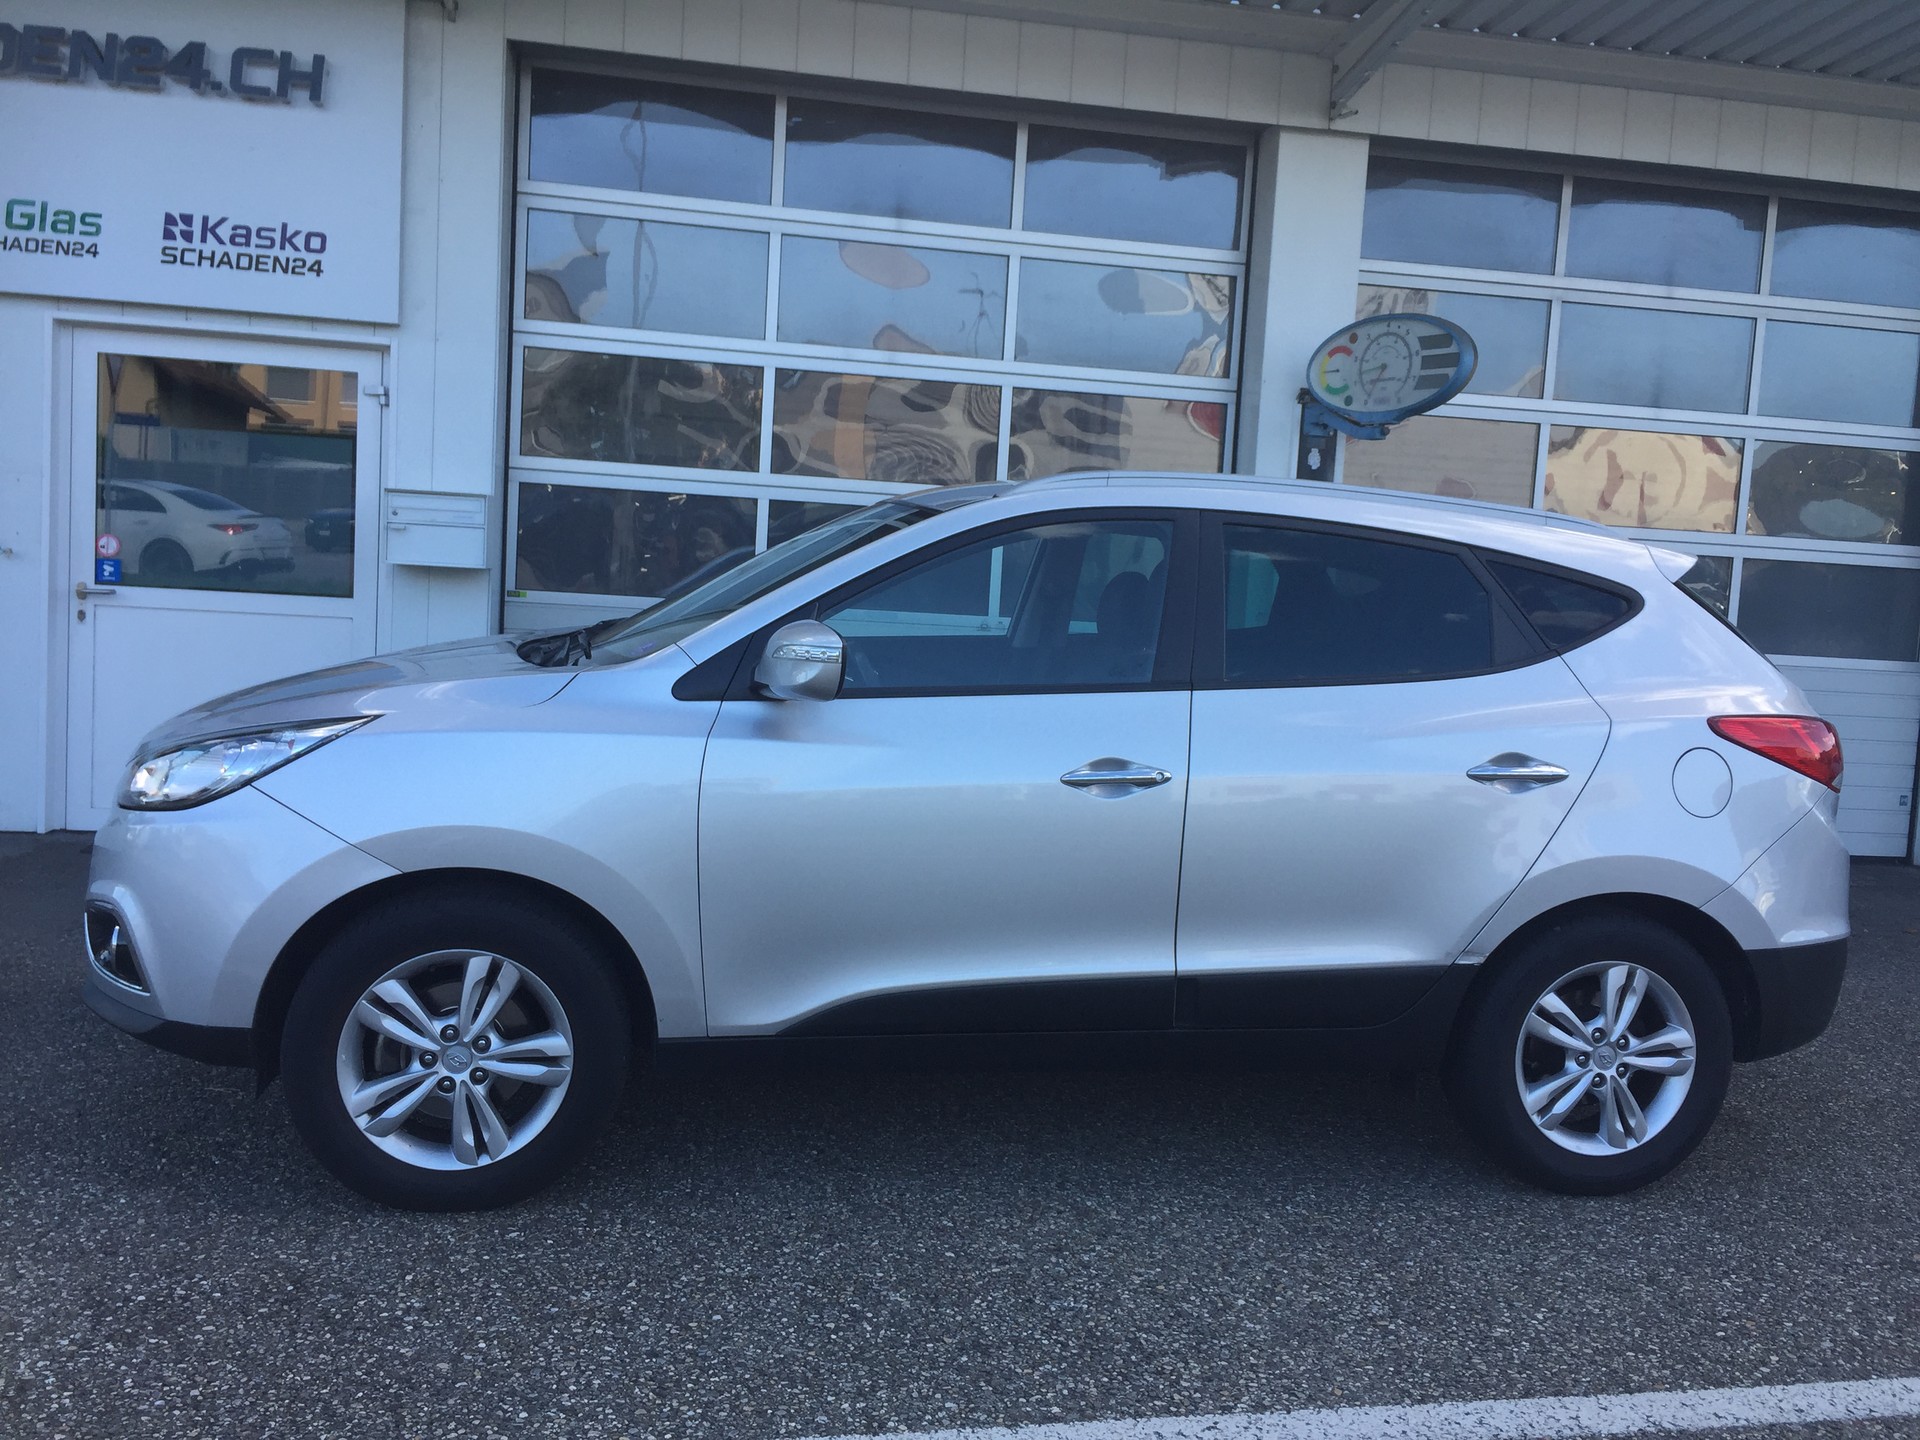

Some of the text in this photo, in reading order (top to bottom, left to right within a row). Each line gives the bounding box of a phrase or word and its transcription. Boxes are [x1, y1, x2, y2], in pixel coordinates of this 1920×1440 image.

[5, 198, 102, 236] Glas
[200, 214, 327, 254] Kasko
[160, 245, 324, 277] SCHADEN24
